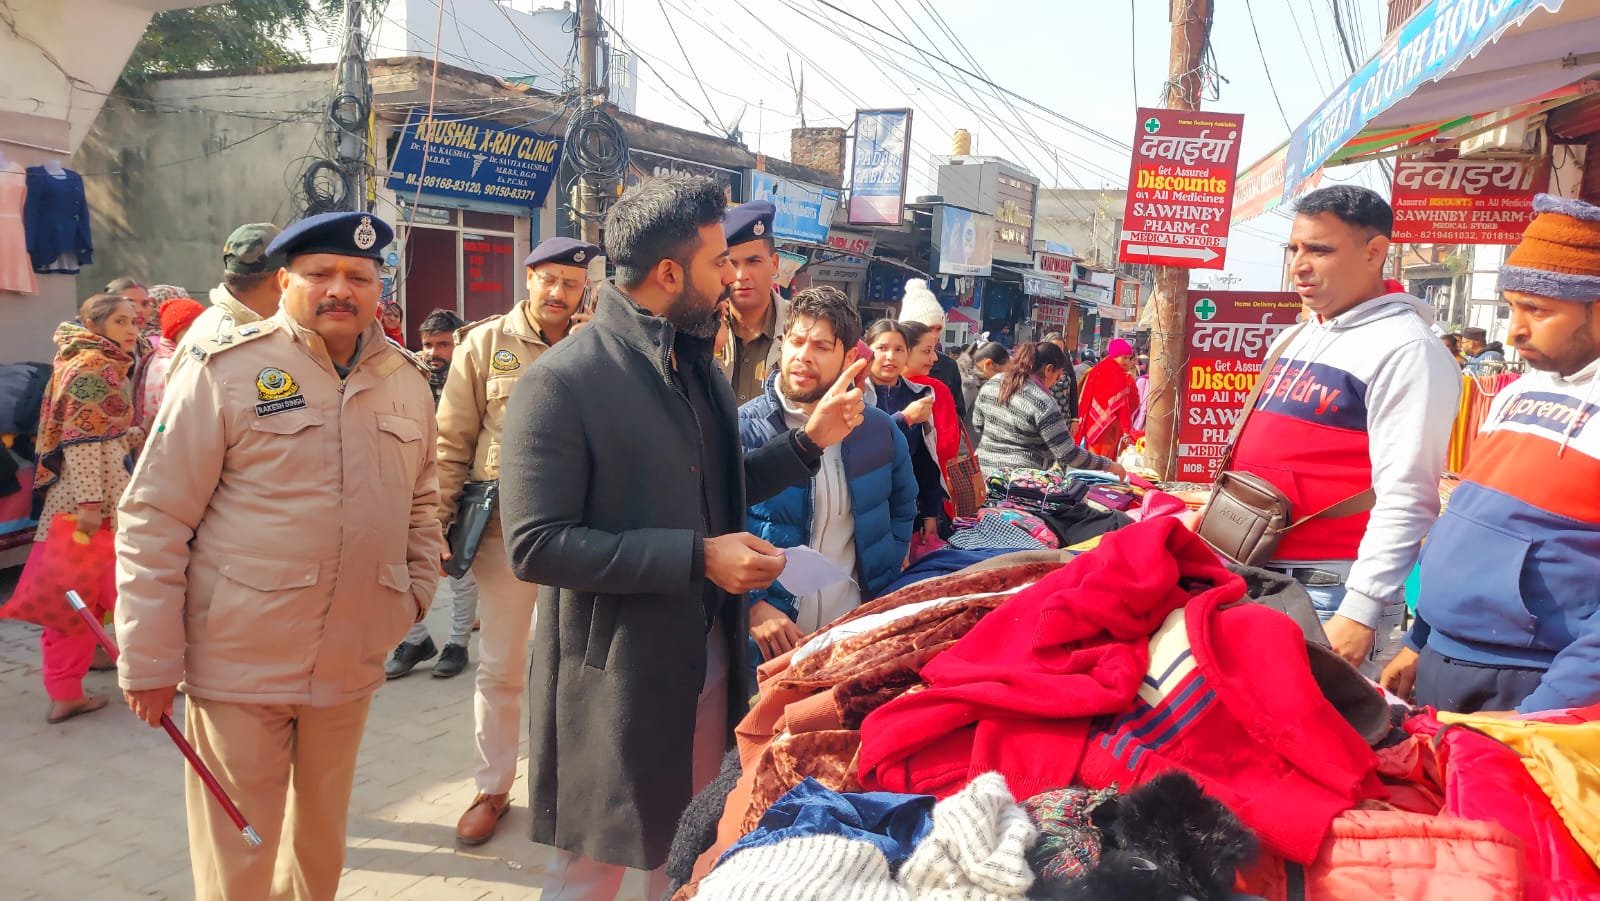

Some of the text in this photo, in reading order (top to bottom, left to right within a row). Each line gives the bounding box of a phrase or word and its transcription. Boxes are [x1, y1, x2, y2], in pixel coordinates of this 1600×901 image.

[1302, 86, 1361, 172] AKSHAY
[1361, 28, 1429, 113] CLOTH
[414, 115, 558, 164] KAUSHAL X-RAY CLINIC
[410, 142, 421, 151] Dr.
[438, 147, 471, 159] KAUSHAL
[854, 168, 900, 184] CABLES
[1158, 165, 1209, 178] Get Assured
[423, 176, 482, 195] 98168-83120,
[484, 185, 536, 200] 90150-83371
[1137, 170, 1226, 193] Discounts
[1136, 190, 1224, 204] on All Medicines
[1396, 198, 1427, 206] Assured
[1501, 198, 1533, 207] Medicin
[1143, 219, 1209, 234] PHARM-C
[1130, 232, 1220, 247] MEDICAL STORE
[1253, 301, 1276, 309] Delivery
[1215, 360, 1231, 372] Get
[1191, 392, 1206, 402] on
[1211, 391, 1229, 402] All
[258, 398, 305, 413] RAKESH SINGH
[1189, 408, 1242, 426] SAW
[1202, 429, 1234, 443] PHA
[1183, 463, 1205, 473] MOB:
